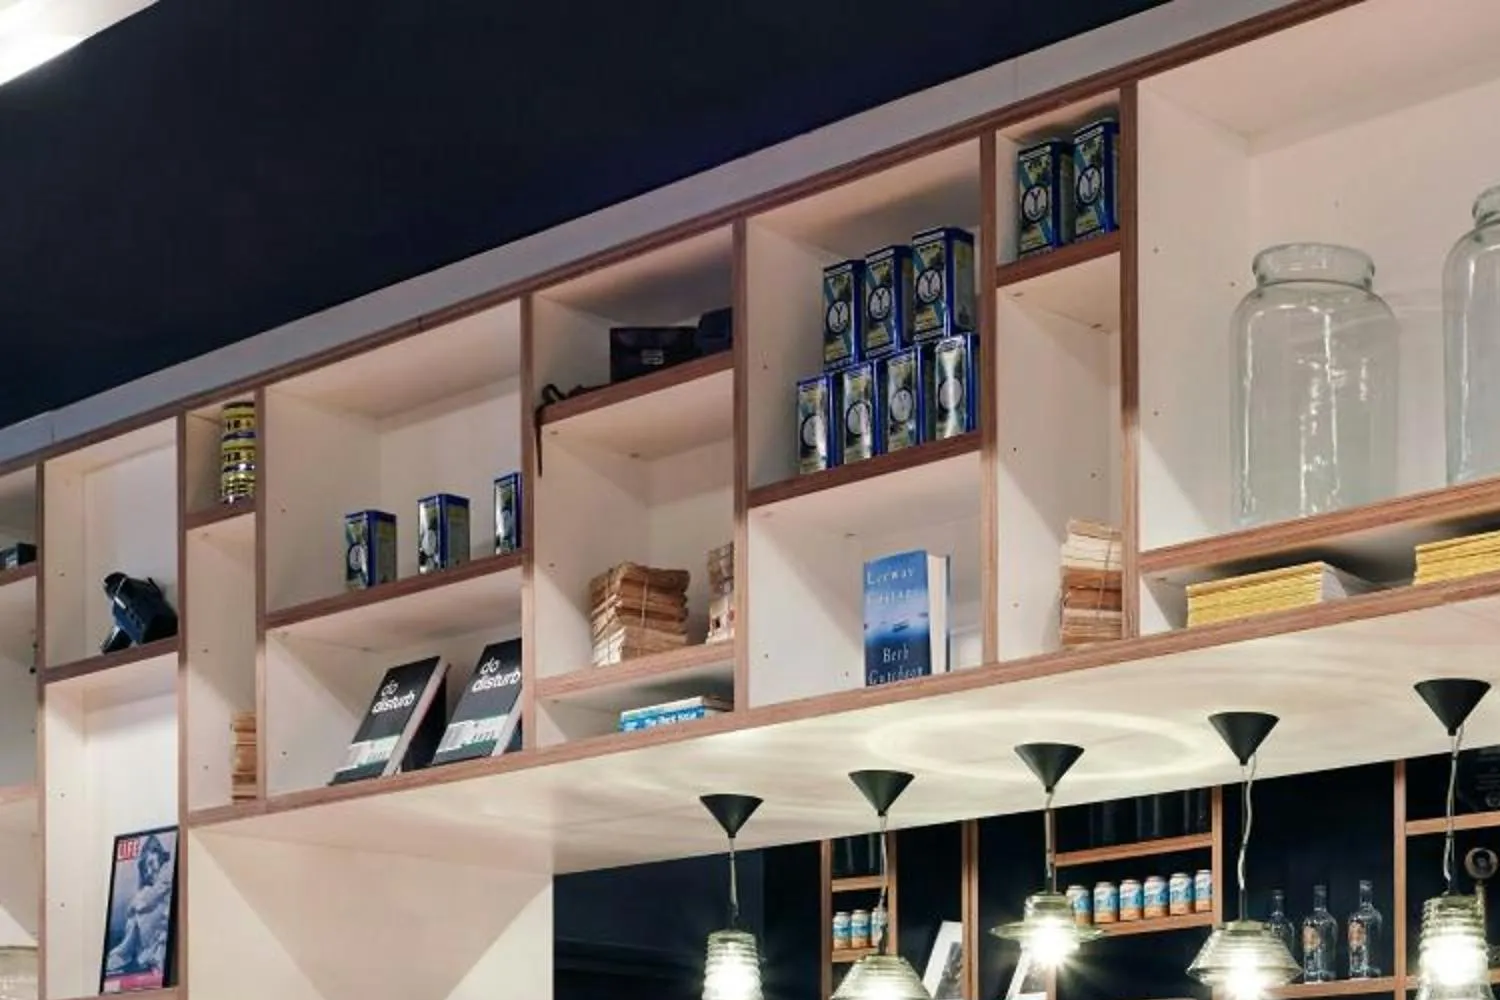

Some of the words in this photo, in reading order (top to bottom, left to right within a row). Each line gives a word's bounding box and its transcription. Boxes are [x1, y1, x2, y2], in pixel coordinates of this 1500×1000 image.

[479, 656, 500, 675] do
[472, 667, 521, 693] disturb
[371, 689, 416, 714] disturb
[118, 839, 139, 861] LIFE
